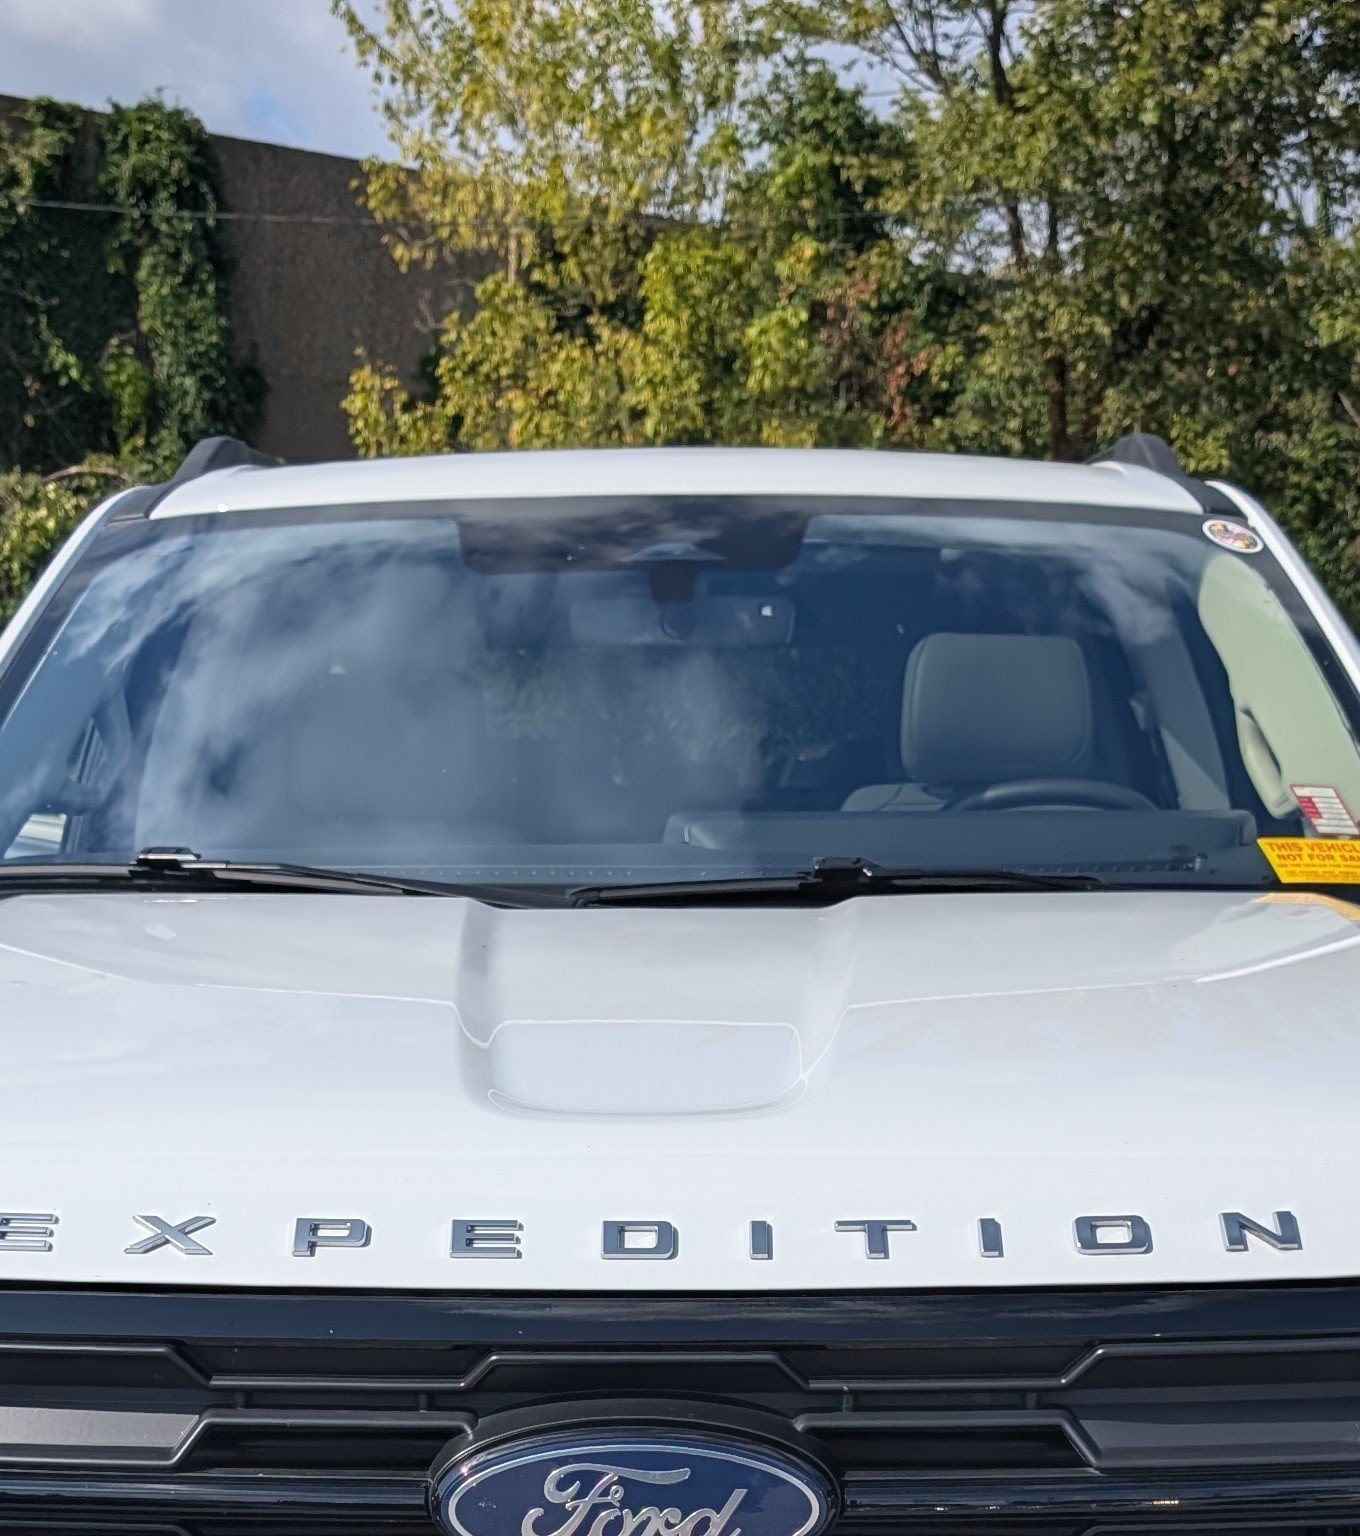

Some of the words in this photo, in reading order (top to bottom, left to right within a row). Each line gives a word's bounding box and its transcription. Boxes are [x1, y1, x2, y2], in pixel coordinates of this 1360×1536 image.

[1266, 842, 1303, 852] THIS
[1276, 853, 1304, 862] NOT
[1307, 853, 1337, 862] FOR
